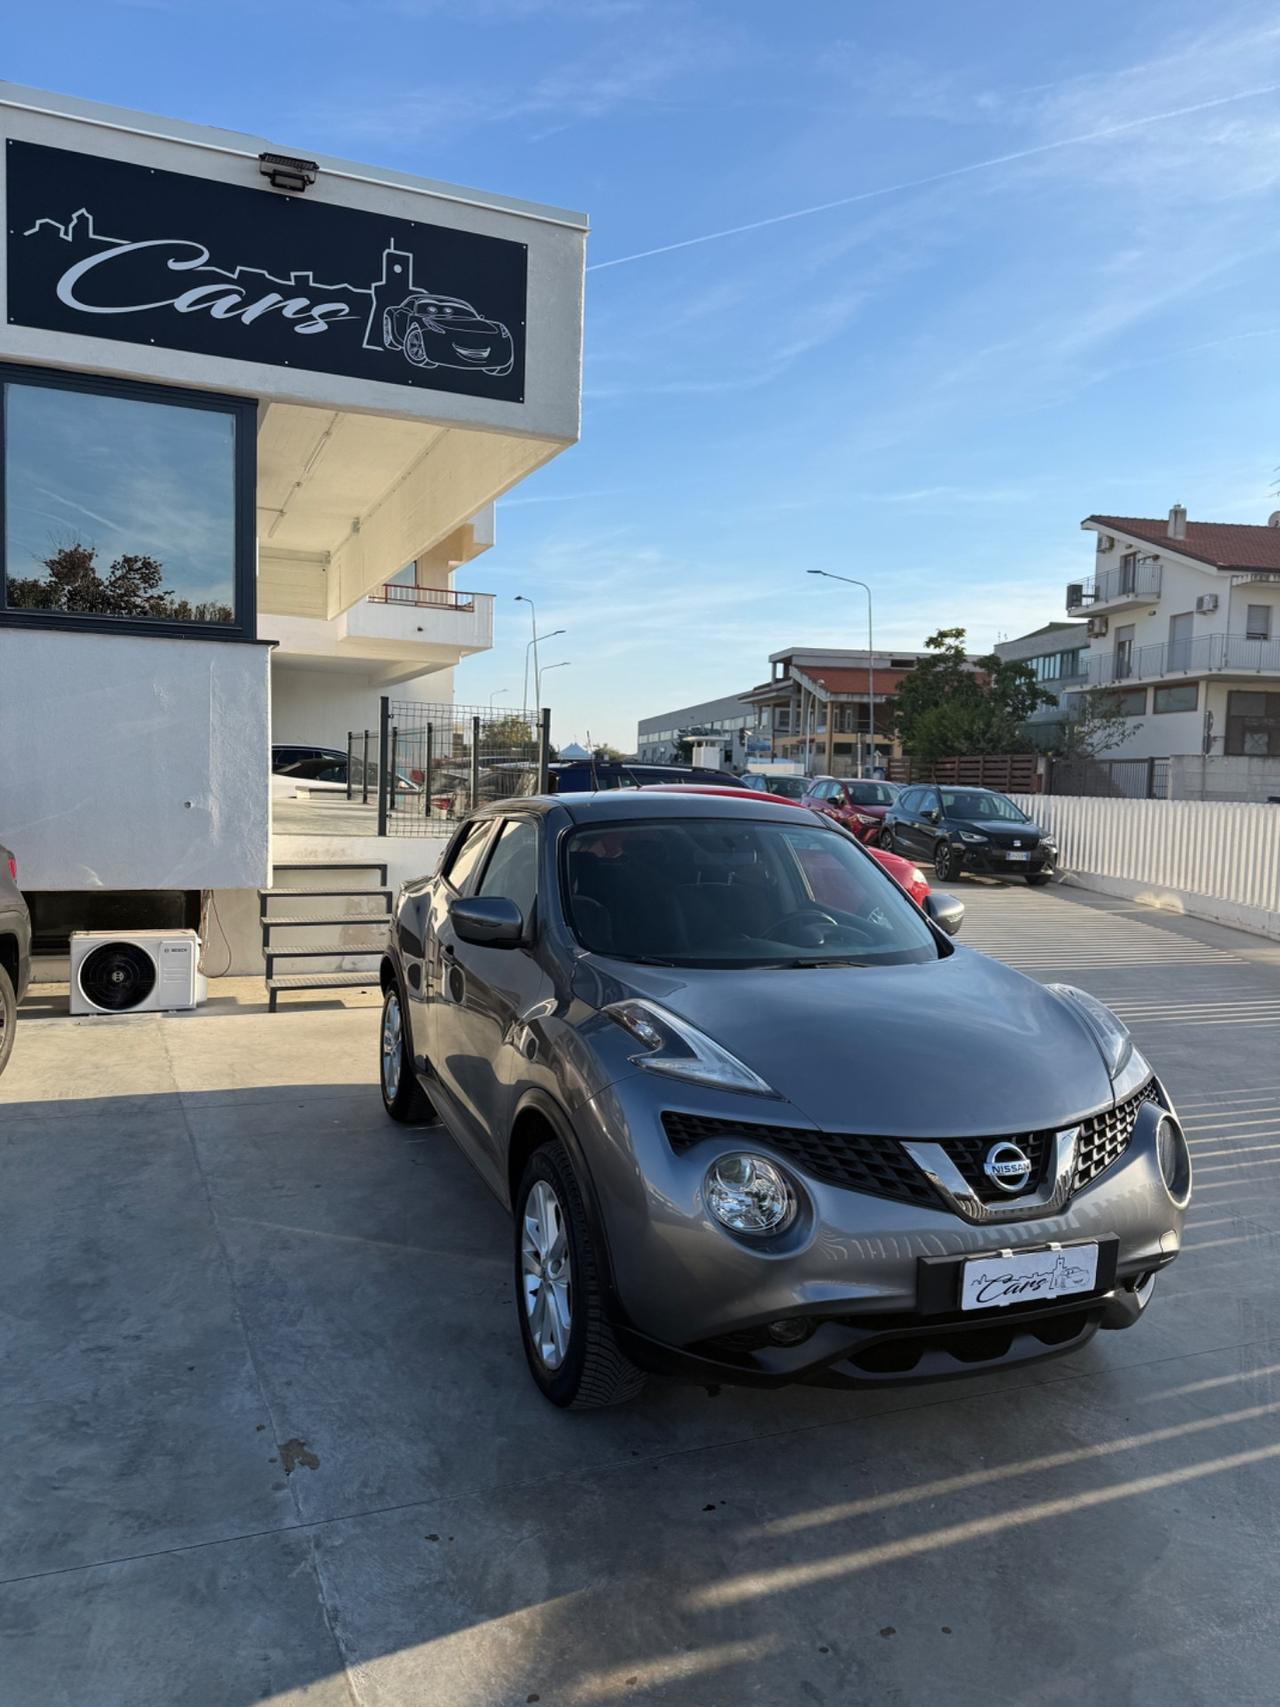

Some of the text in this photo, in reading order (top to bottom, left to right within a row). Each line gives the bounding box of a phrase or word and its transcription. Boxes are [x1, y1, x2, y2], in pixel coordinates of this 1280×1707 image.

[56, 239, 361, 334] Cars
[991, 1162, 1030, 1173] NISSAN
[976, 1273, 1048, 1303] Cars
